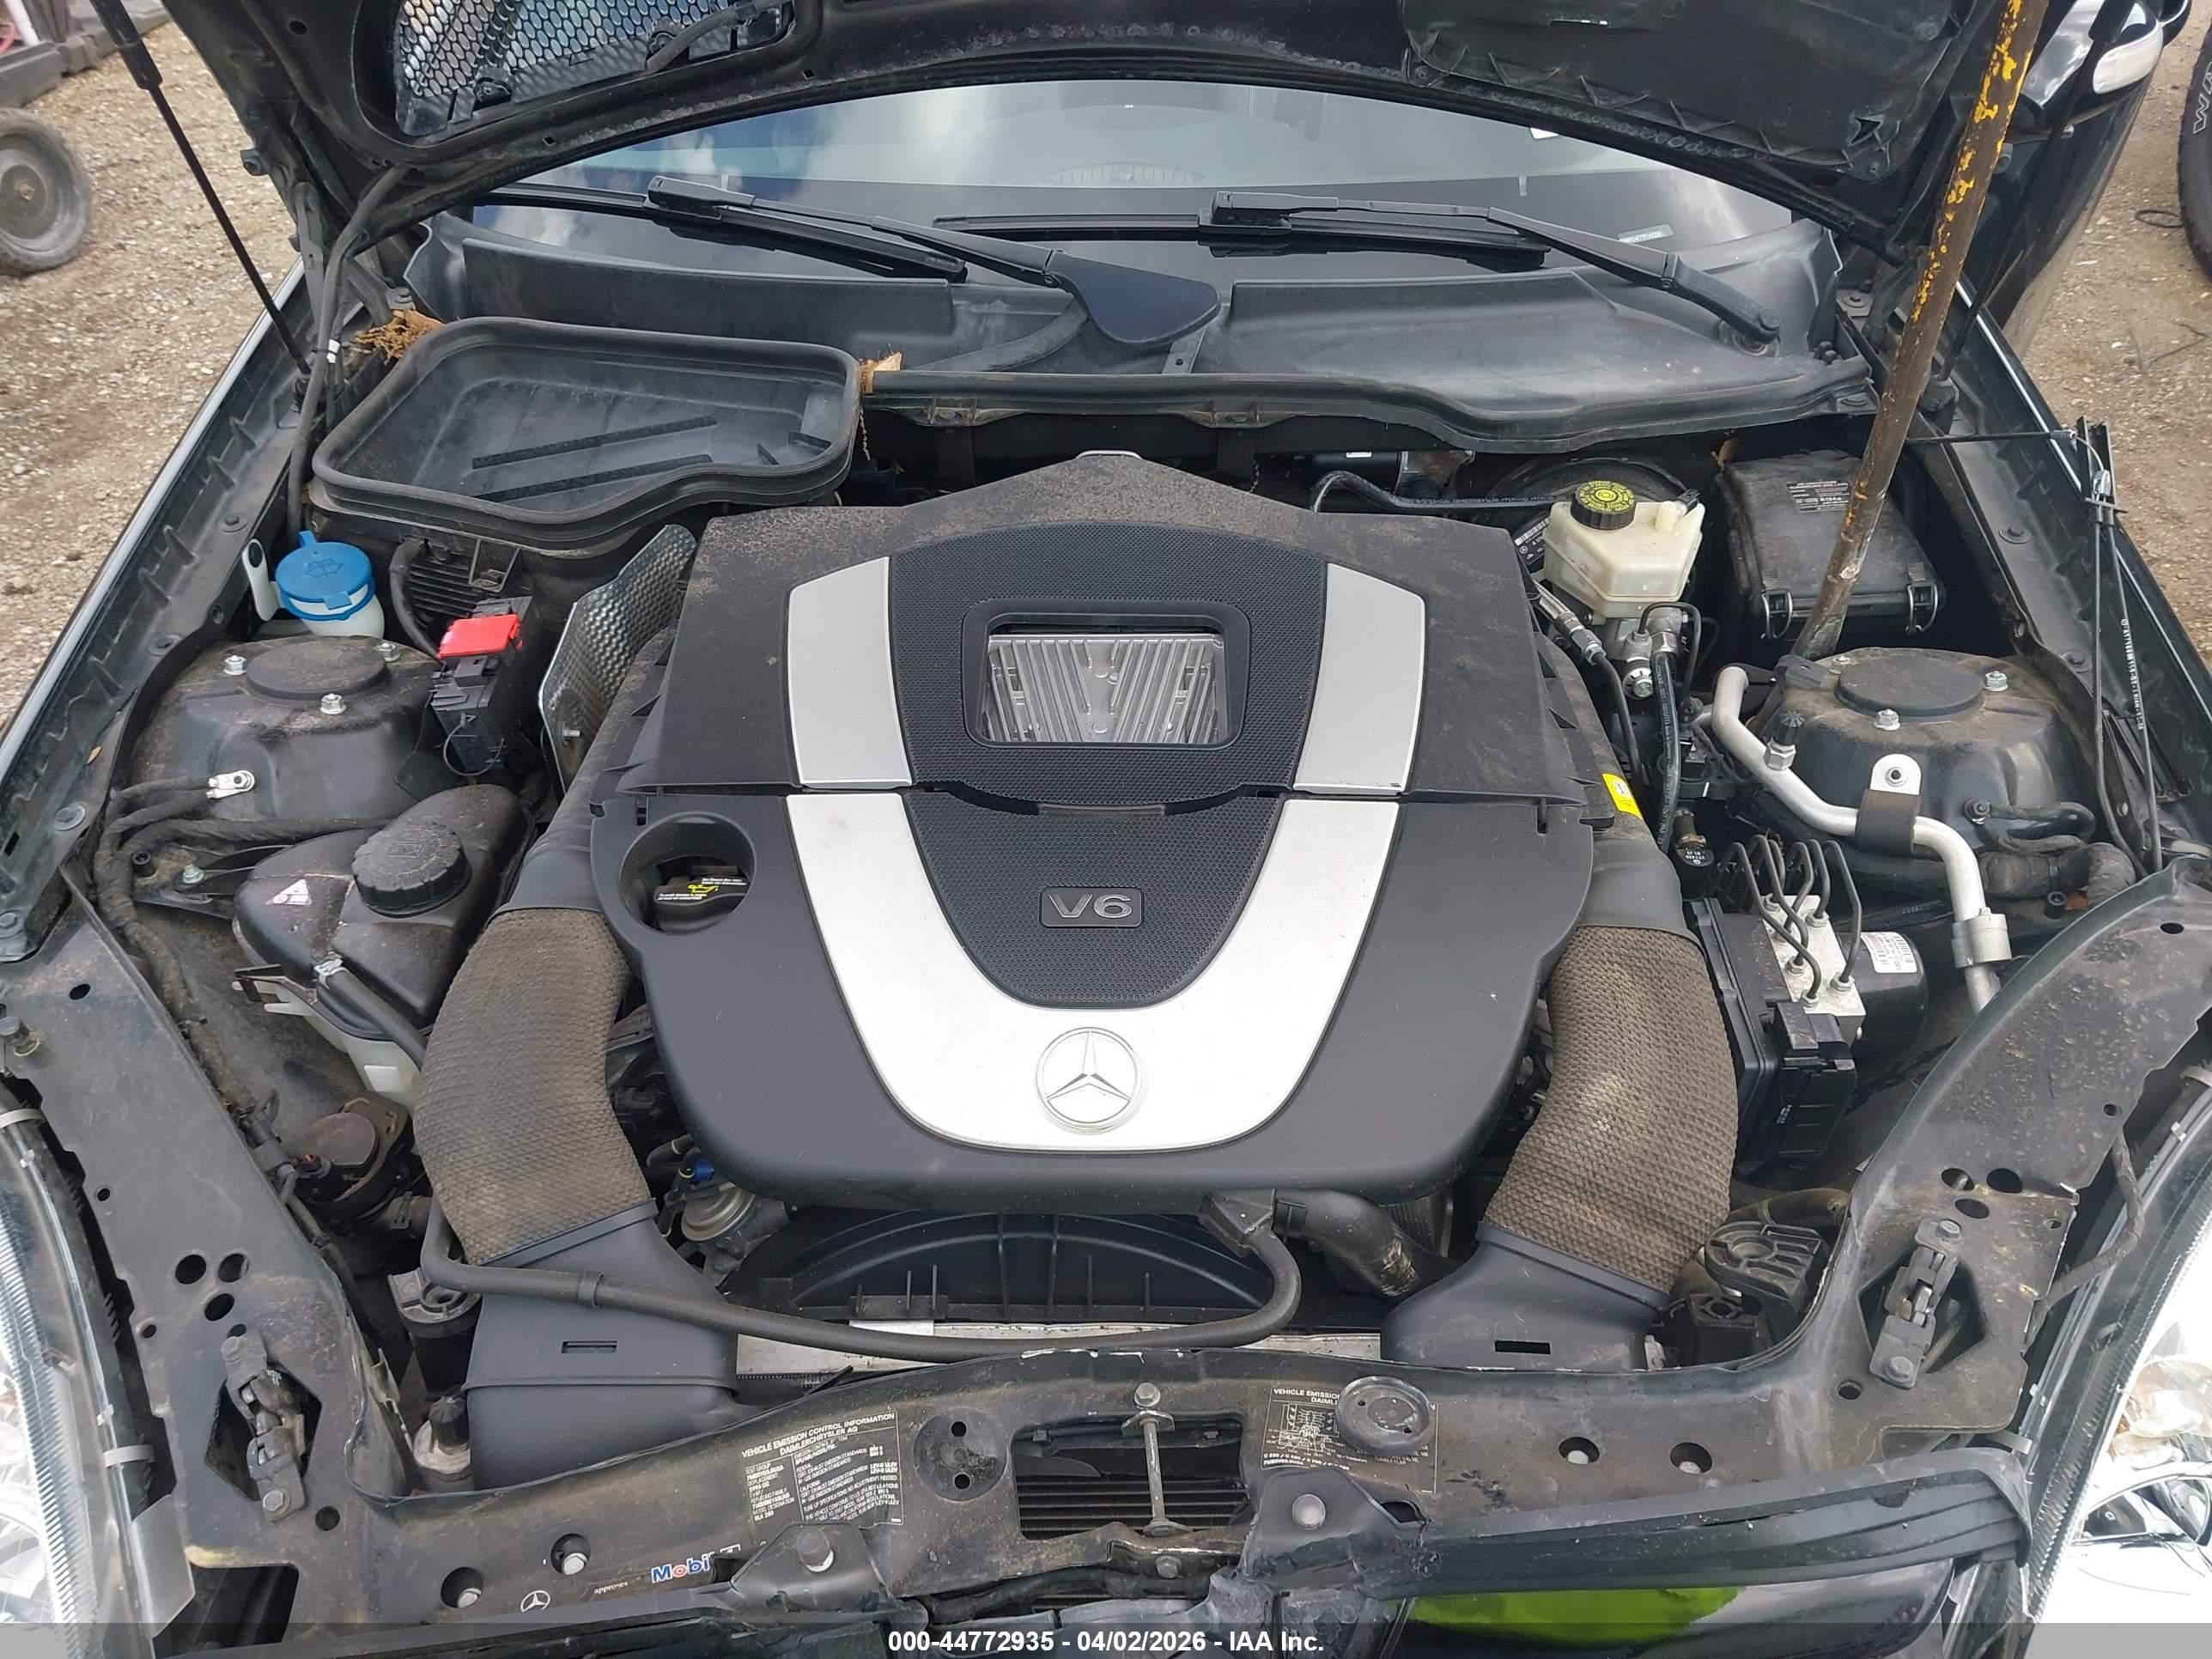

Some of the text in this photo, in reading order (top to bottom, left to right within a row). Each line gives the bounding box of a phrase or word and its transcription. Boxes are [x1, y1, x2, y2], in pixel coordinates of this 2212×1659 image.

[1048, 893, 1133, 918] V6
[742, 1413, 895, 1458] VEHICLE EMISSION CONTROL INFORMATION
[780, 1428, 846, 1455] DAIMLERCHRYSLER
[651, 1551, 715, 1583] Mobi
